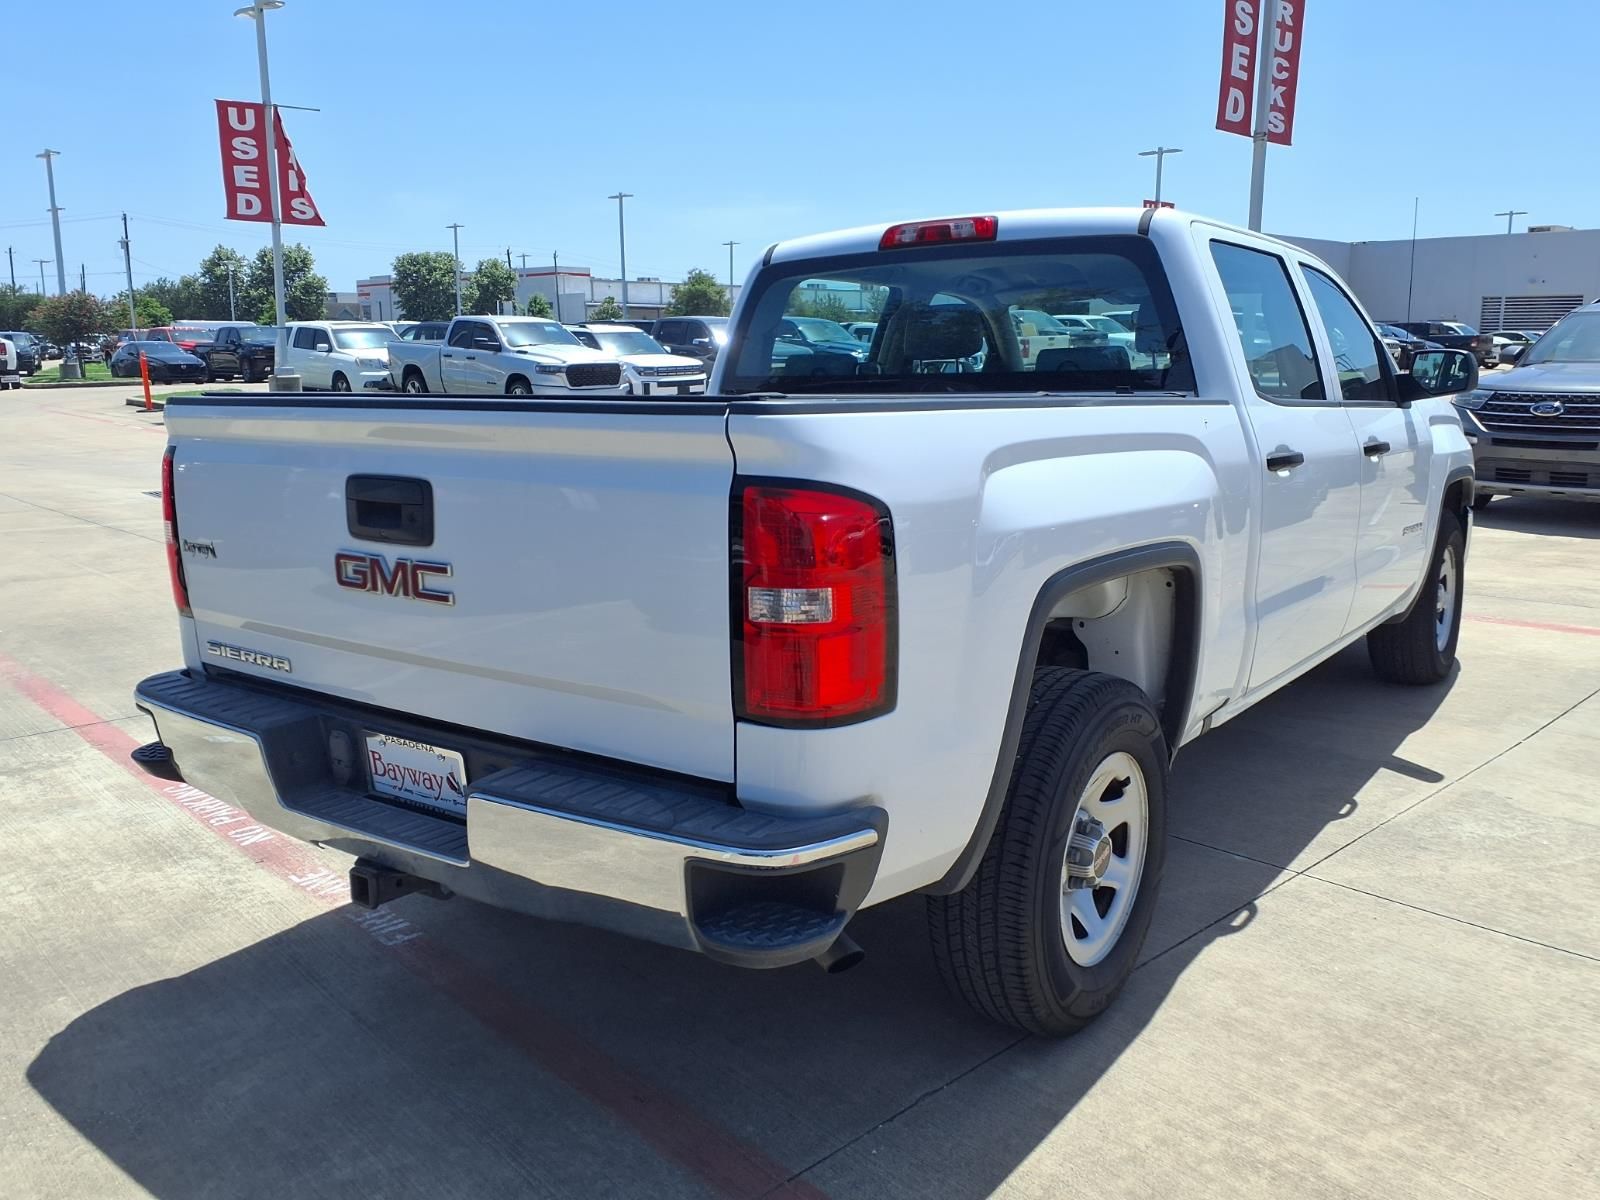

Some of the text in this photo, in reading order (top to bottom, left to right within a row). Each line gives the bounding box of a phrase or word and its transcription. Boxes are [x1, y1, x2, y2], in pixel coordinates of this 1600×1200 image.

[1225, 0, 1254, 122] SED
[1268, 1, 1294, 134] RUCKS
[227, 106, 262, 215] USED
[335, 549, 455, 605] GMC
[206, 640, 292, 673] SIERRA
[385, 735, 435, 753] PASADENA
[370, 750, 443, 800] Bayway
[163, 783, 247, 826] PARKING
[228, 825, 274, 846] NO
